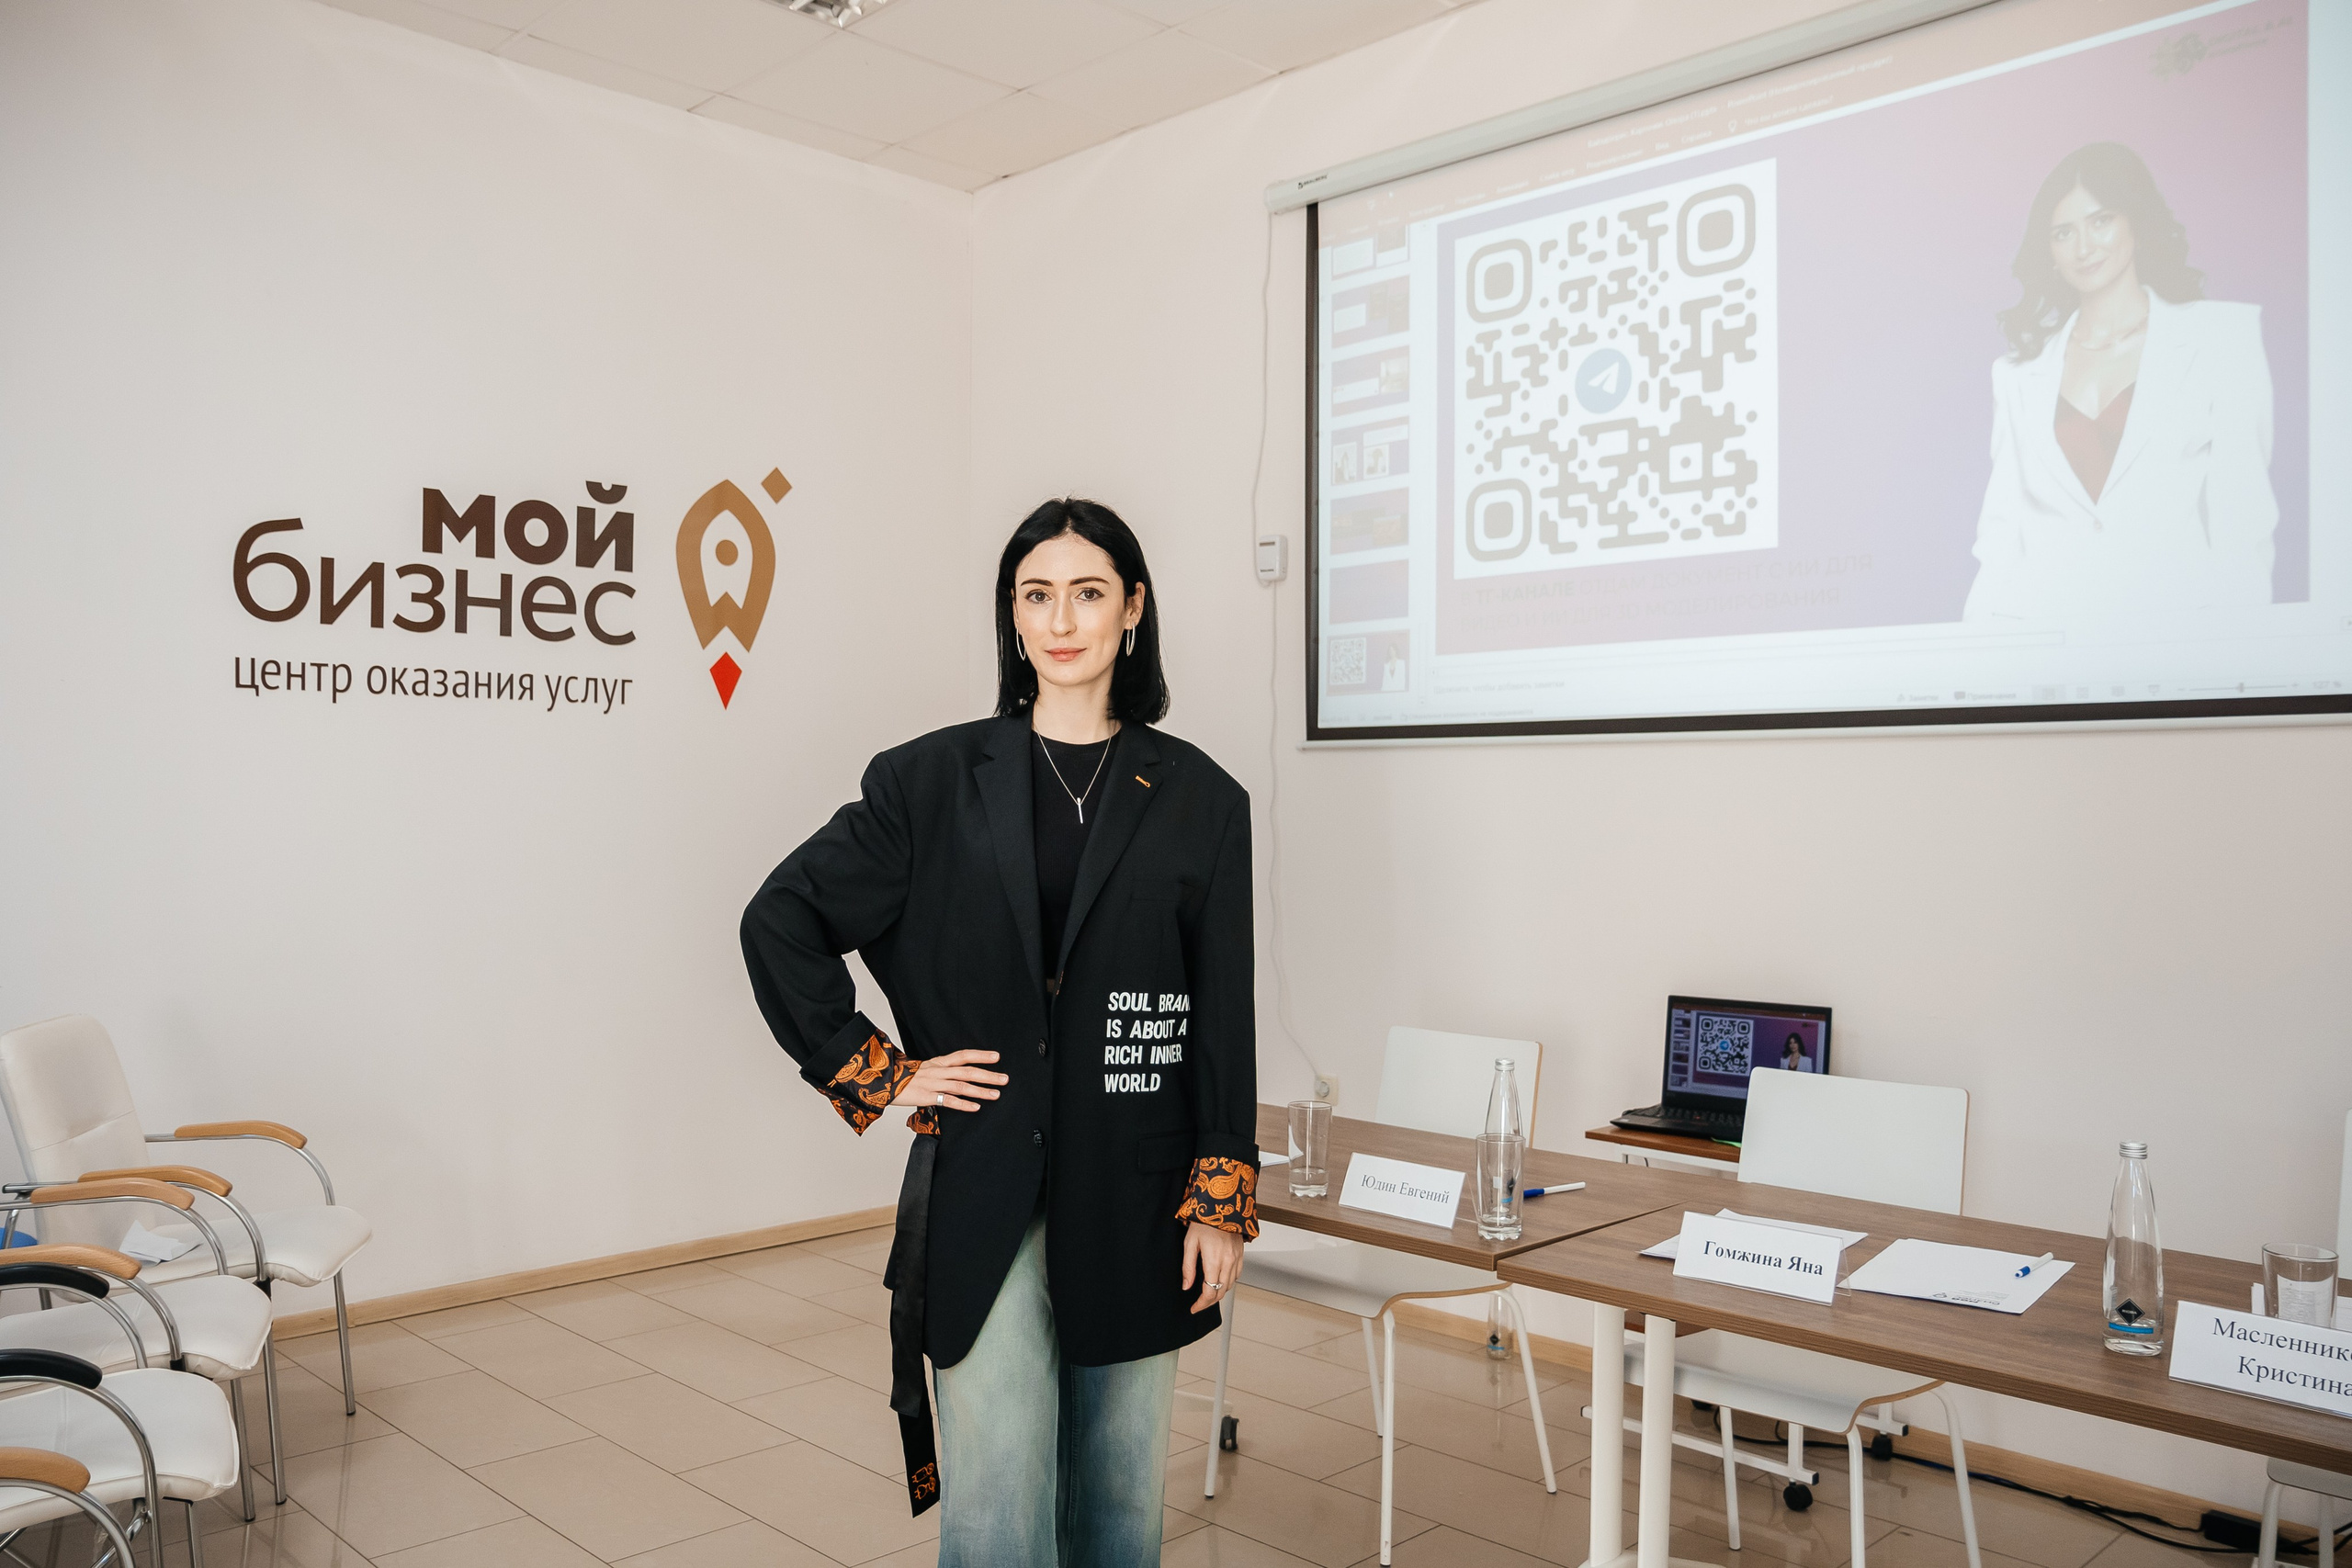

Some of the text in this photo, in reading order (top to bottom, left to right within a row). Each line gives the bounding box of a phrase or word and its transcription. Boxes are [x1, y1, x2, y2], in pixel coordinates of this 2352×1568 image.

[423, 480, 634, 572] мой
[233, 518, 636, 645] бизнес
[235, 658, 632, 714] центр оказания услуг
[1108, 992, 1152, 1011] SOUL
[1106, 1019, 1187, 1039] IS ABOUT A
[1104, 1043, 1182, 1065] RICH INNER
[1104, 1074, 1160, 1093] WORLD
[1362, 1175, 1450, 1204] Юдин Евгений
[1703, 1241, 1823, 1275] Гомжина Яна
[2213, 1317, 2352, 1362] Масленник
[2237, 1355, 2352, 1396] Кристина
